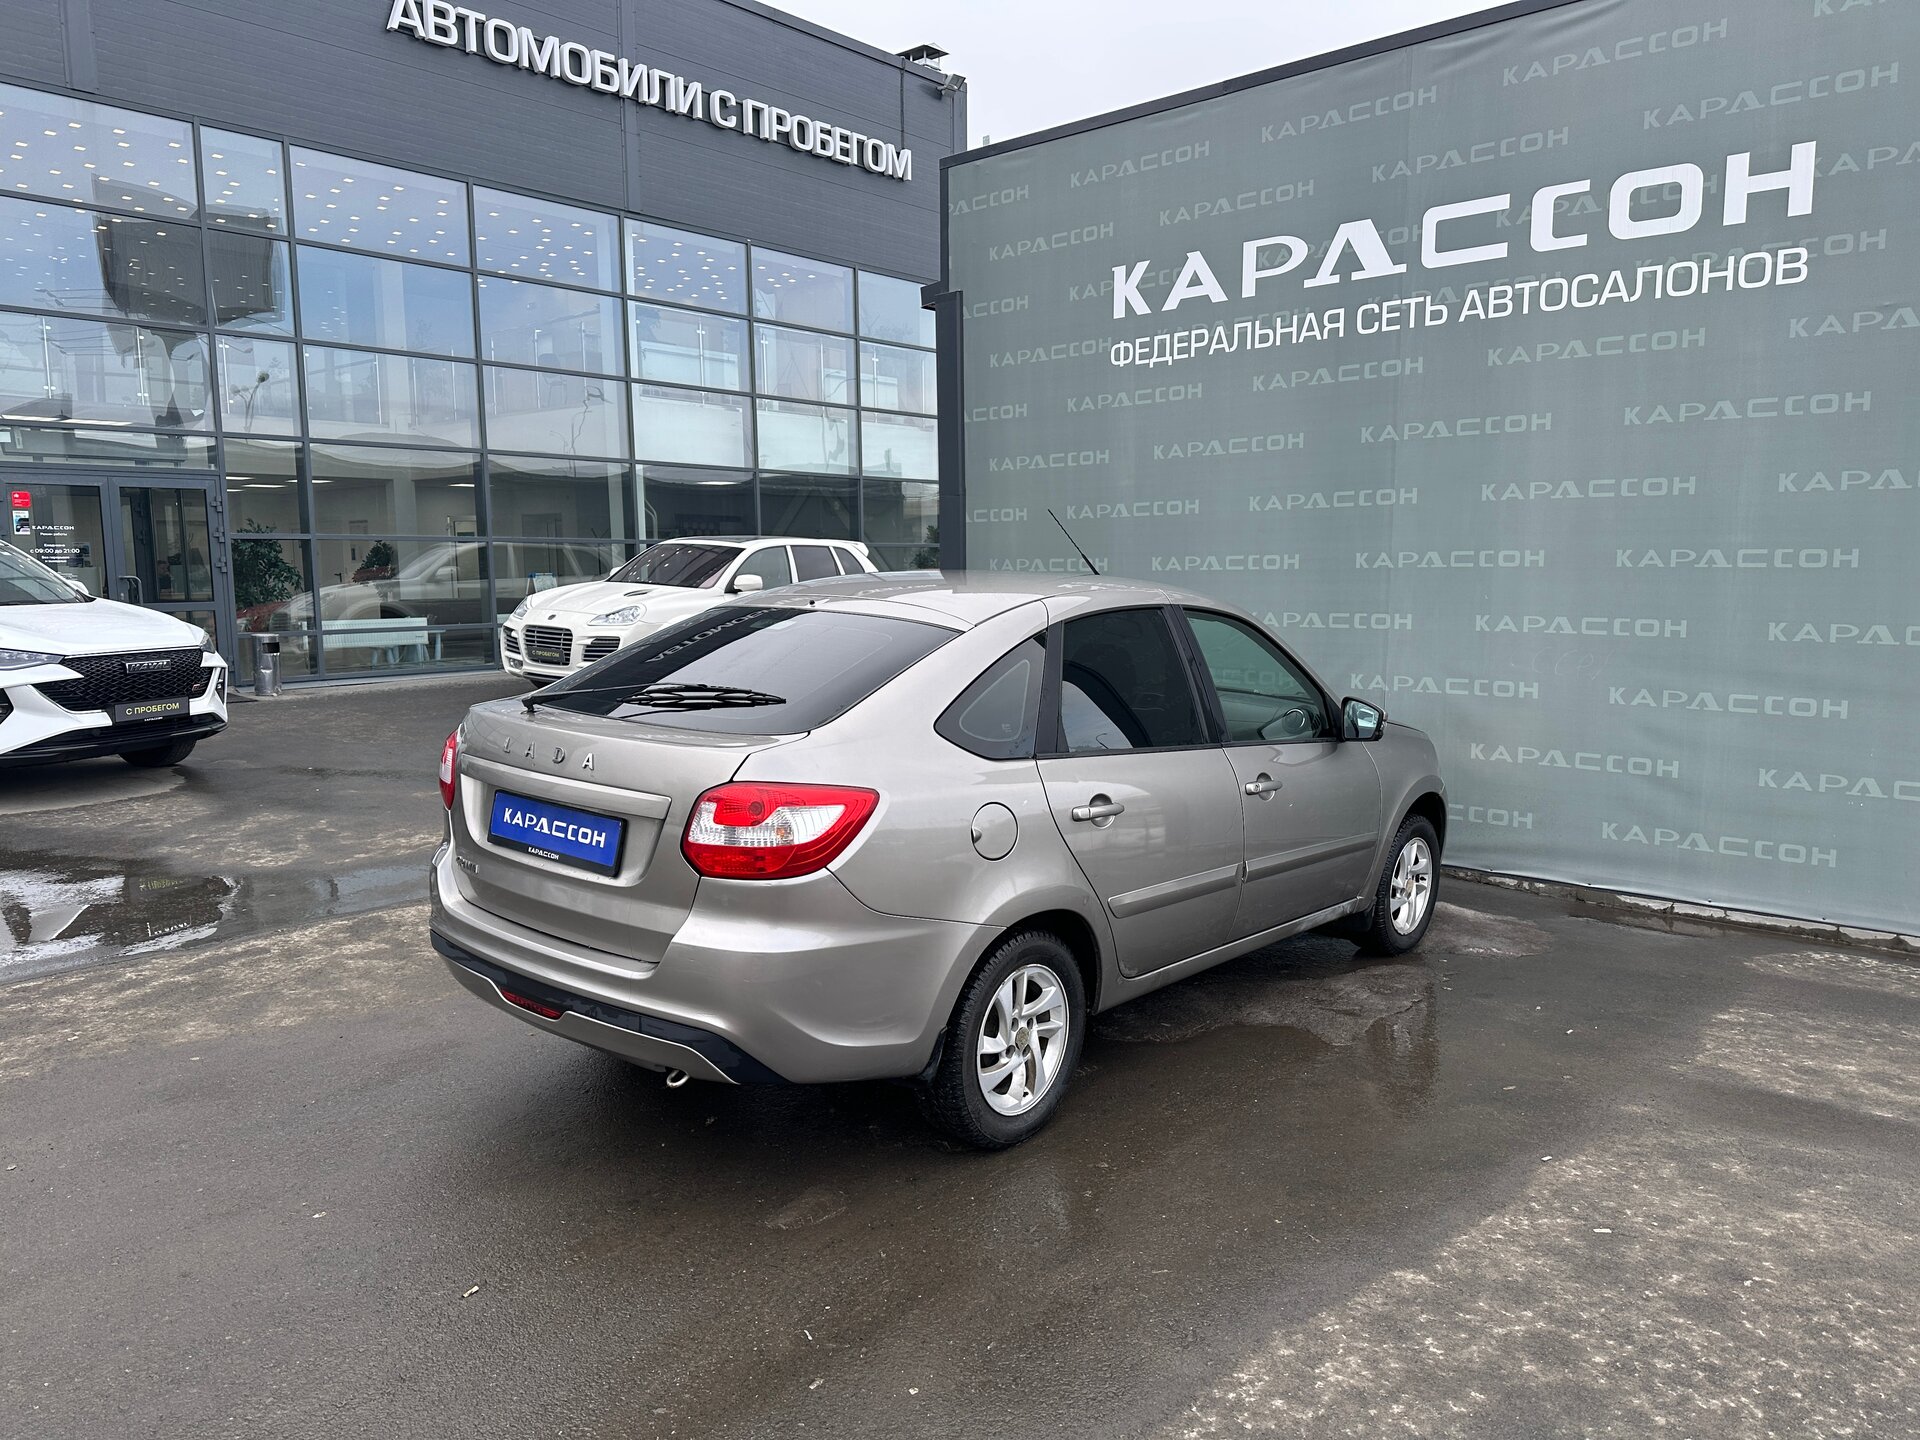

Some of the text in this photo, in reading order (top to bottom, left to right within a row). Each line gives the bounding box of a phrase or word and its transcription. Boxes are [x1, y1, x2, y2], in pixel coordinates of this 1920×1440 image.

[1503, 18, 1728, 87] КАРАССОН
[387, 0, 912, 181] АВТОМОБИЛИ С ПРОБЕГОМ
[1643, 61, 1900, 129] КАРАССОН
[1261, 85, 1437, 143] КАРАССОН
[1070, 140, 1210, 188] КАРАССОН
[1371, 126, 1569, 184] КАРАССОН
[1159, 179, 1315, 227] КАРАССОН
[990, 222, 1114, 262] КАРАССОН
[1112, 141, 1817, 320] КАРАССОН
[1110, 247, 1809, 368] ФЕДЕРАЛЬНАЯ СЕТЬ АВТОСАЛОНОВ
[990, 337, 1112, 368] КАРАССОН
[1487, 328, 1706, 367] КАРАССОН
[1252, 357, 1424, 392] КАРАССОН
[1067, 382, 1202, 413] КАРАССОН
[1624, 391, 1872, 426] КАРАССОН
[1360, 413, 1552, 443] КАРАССОН
[989, 449, 1110, 472] КАРАССОН
[1153, 433, 1304, 460] КАРАССОН
[1481, 476, 1696, 502] КАРАССОН
[1778, 468, 1920, 493] КАРА
[1066, 499, 1200, 520] КАРАССОН
[1248, 488, 1418, 512] КАРАССОН
[989, 557, 1109, 572] КАРАССОН
[1151, 554, 1300, 572] КАРАССОН
[1355, 549, 1546, 569] КАРАССОН
[1616, 548, 1860, 569] КАРАССОН
[1250, 612, 1413, 630] АРАССОН
[1475, 614, 1688, 639] КАРАССОН
[1350, 673, 1539, 700] КАРАССОН
[1609, 686, 1849, 719] КАРАССОН
[134, 703, 180, 714] ПРОБЕГОМ
[503, 737, 595, 771] LADA
[1470, 742, 1680, 779] КАРАССОН
[503, 807, 606, 848] КАРАССОН
[528, 846, 560, 860] КАРАССОН
[1602, 822, 1837, 868] КАРАССОН
